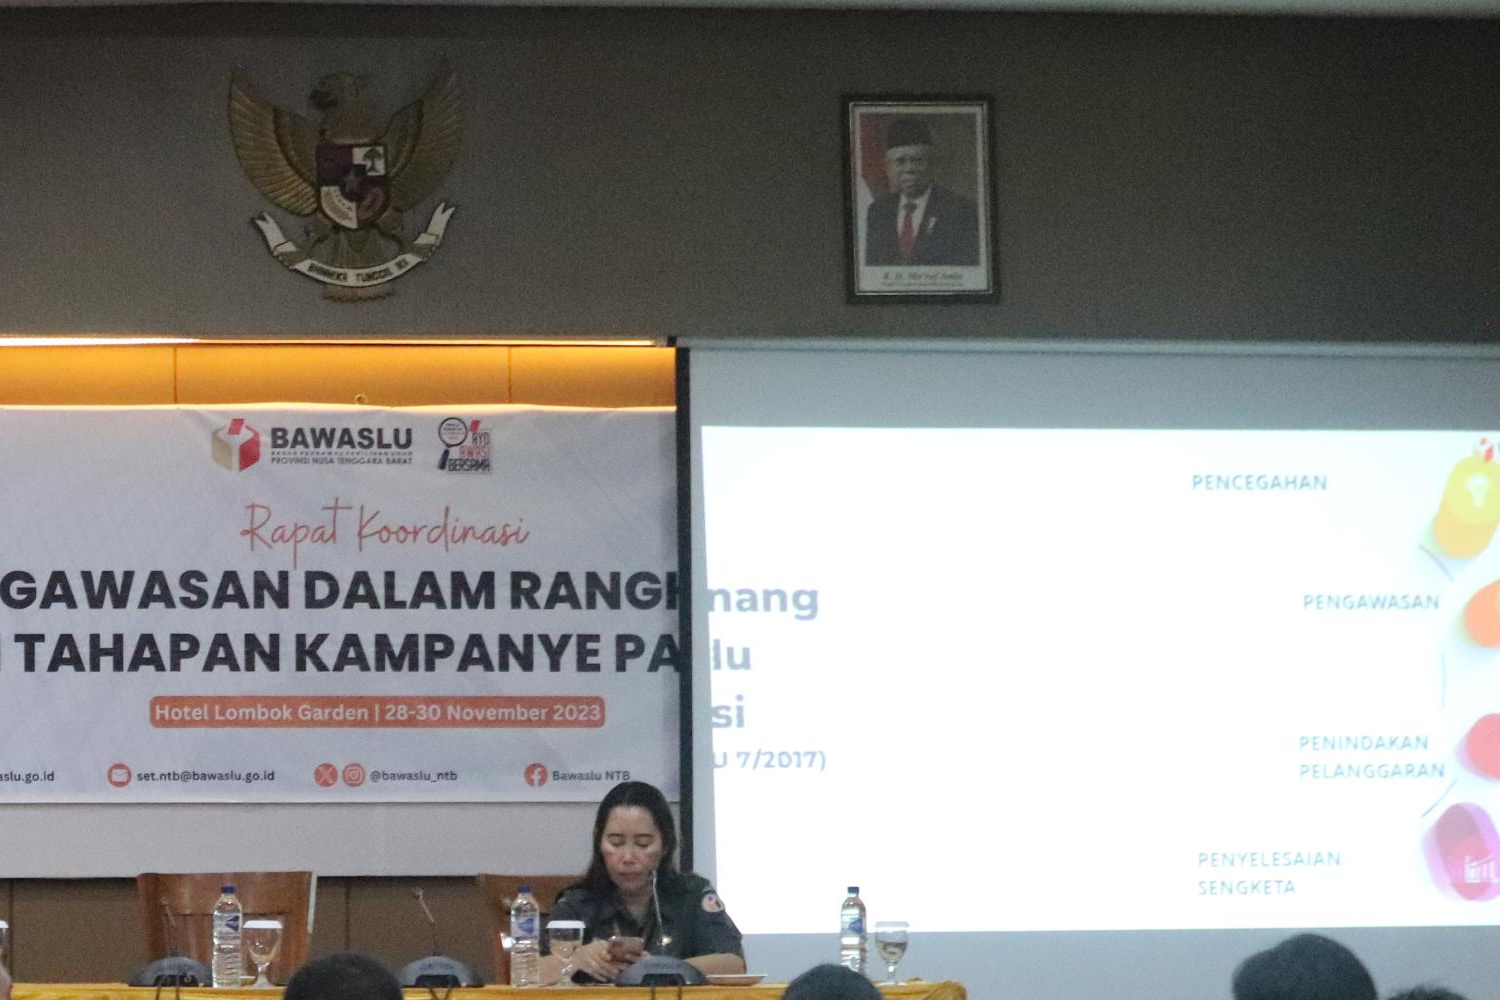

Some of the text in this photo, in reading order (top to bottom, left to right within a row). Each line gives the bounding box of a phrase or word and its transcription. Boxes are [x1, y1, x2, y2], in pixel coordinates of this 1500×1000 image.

[270, 427, 413, 450] BAWASLU
[311, 457, 334, 465] NUSA
[385, 457, 413, 465] BARAT
[1192, 474, 1328, 491] PENCEGAHAN
[240, 496, 530, 571] Rapat Koordinasi
[304, 570, 496, 610] DALAM
[1303, 594, 1440, 610] PENGAWASAN
[13, 633, 281, 673] TAHAPAN
[295, 633, 603, 673] KAMPANYE
[155, 704, 209, 721] Hotel
[214, 704, 293, 721] Lombok
[297, 704, 369, 721] Garden
[385, 704, 441, 721] 28-30
[447, 704, 548, 721] November
[552, 704, 601, 721] 2023
[1300, 735, 1429, 751] PENINDAKAN
[735, 748, 827, 772] 7/2017)
[136, 770, 275, 784] set.ntb@bawaslu.go.id
[370, 770, 458, 783] @bawaslu_ntb
[552, 770, 631, 782] Bawaslu NTB
[1300, 763, 1446, 779] PELANGGARAN
[1198, 851, 1341, 868] PENYELESAIAN
[1198, 880, 1297, 896] SENGKETA
